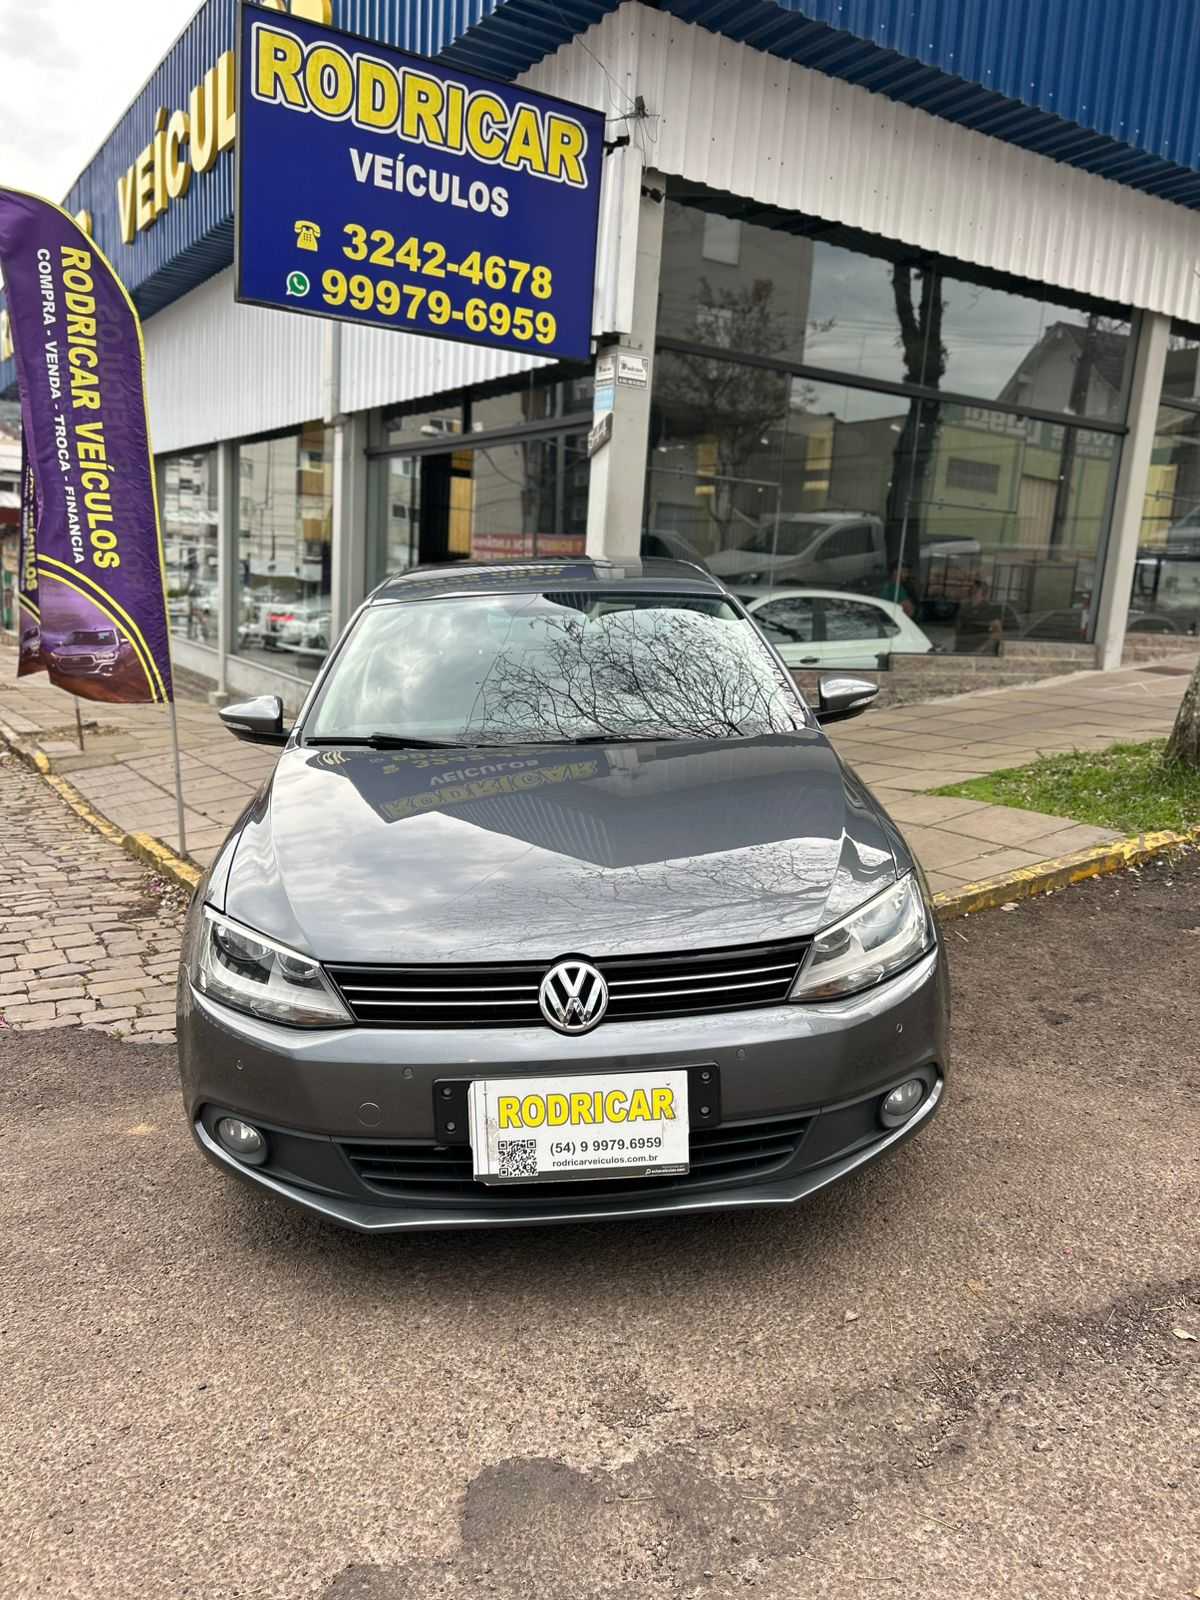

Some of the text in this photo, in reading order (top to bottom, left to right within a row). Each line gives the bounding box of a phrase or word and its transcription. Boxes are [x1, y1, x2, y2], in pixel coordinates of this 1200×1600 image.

[251, 22, 588, 188] RODRICAR
[349, 148, 510, 218] VEÍCULOS
[37, 248, 56, 325] COMPRA
[342, 223, 552, 299] 3242-4678
[60, 246, 101, 410] RODRICAR
[321, 269, 556, 344] 99979-6959
[44, 341, 62, 400] VENDA
[54, 415, 71, 472] TROCA
[64, 485, 85, 564] FINANCIA
[73, 422, 121, 569] VEÍCULOS
[497, 1088, 676, 1129] RODRICAR
[550, 1137, 662, 1156] (54) 9 9979.6959
[552, 1154, 659, 1168] rodricarveiculos.com.br
